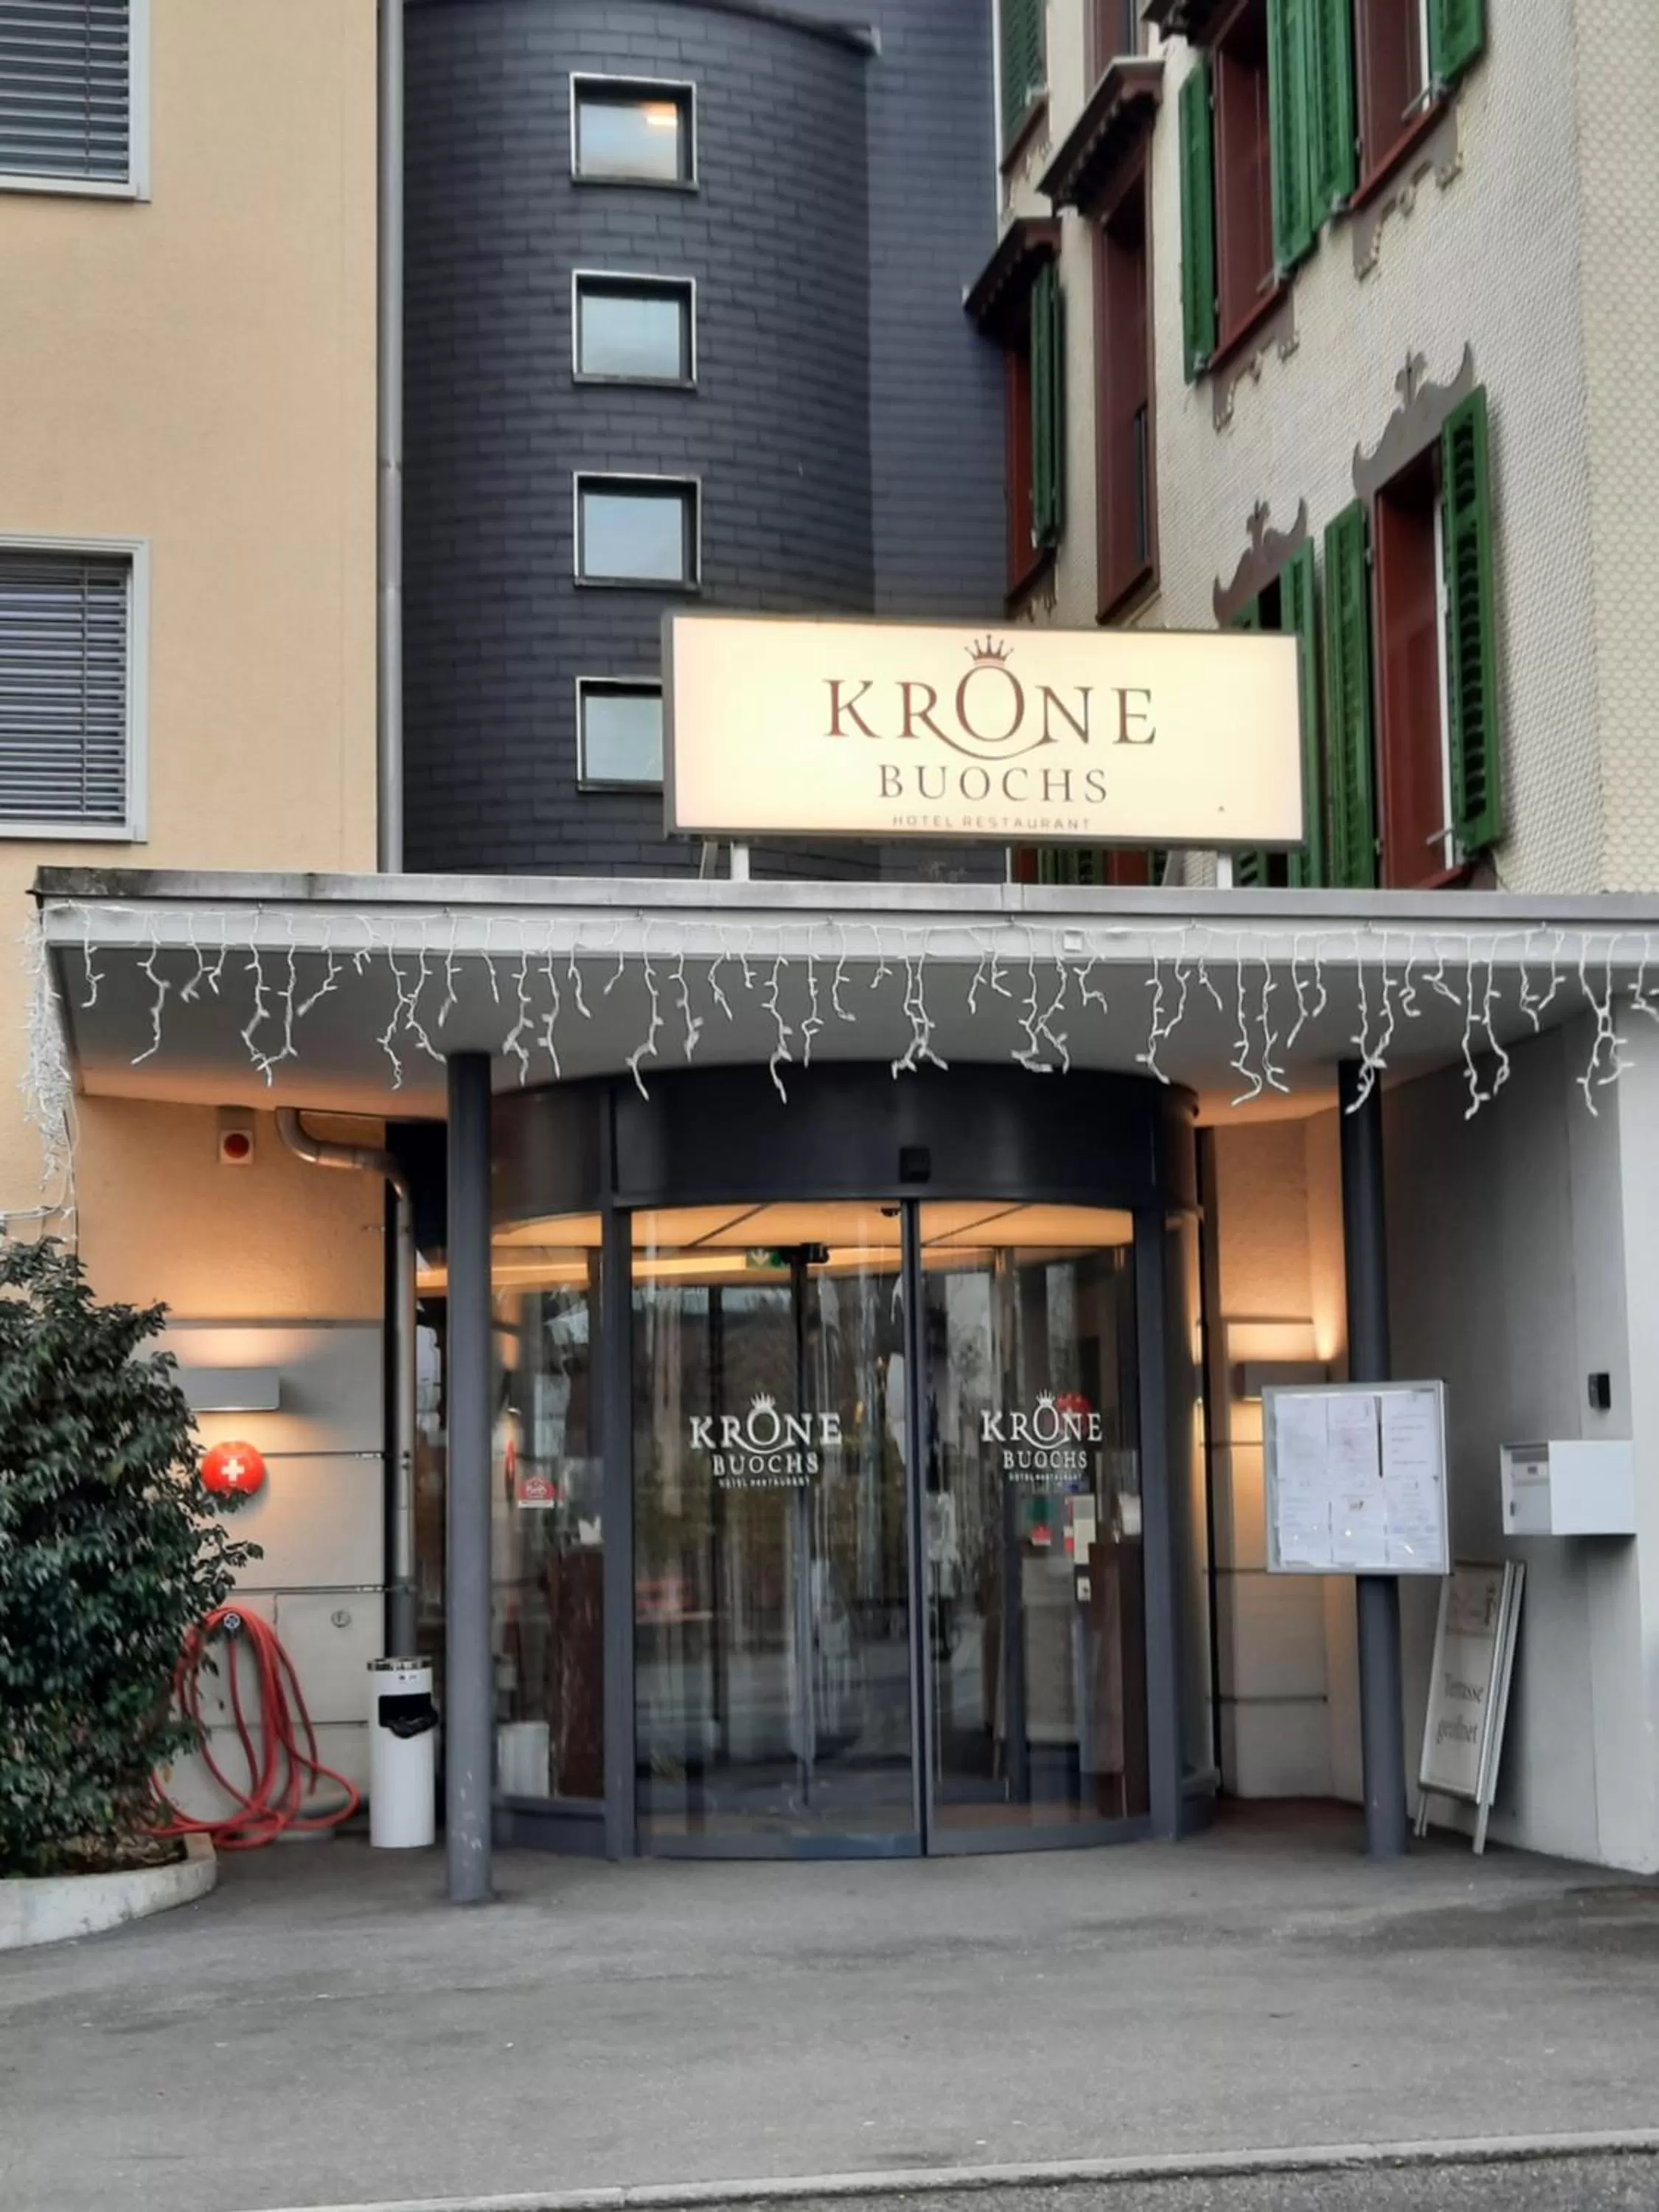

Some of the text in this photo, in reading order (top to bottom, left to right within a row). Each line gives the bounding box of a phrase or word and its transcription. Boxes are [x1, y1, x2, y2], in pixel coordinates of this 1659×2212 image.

[821, 664, 1156, 761] KRONE
[879, 764, 1108, 804] BUOCHS
[892, 814, 1091, 831] HOTEL RESTAURANT
[689, 1409, 843, 1454] KRONE
[981, 1403, 1103, 1450] KRONE
[713, 1452, 818, 1475] BUOCHS
[1004, 1450, 1088, 1469] BUOCHS
